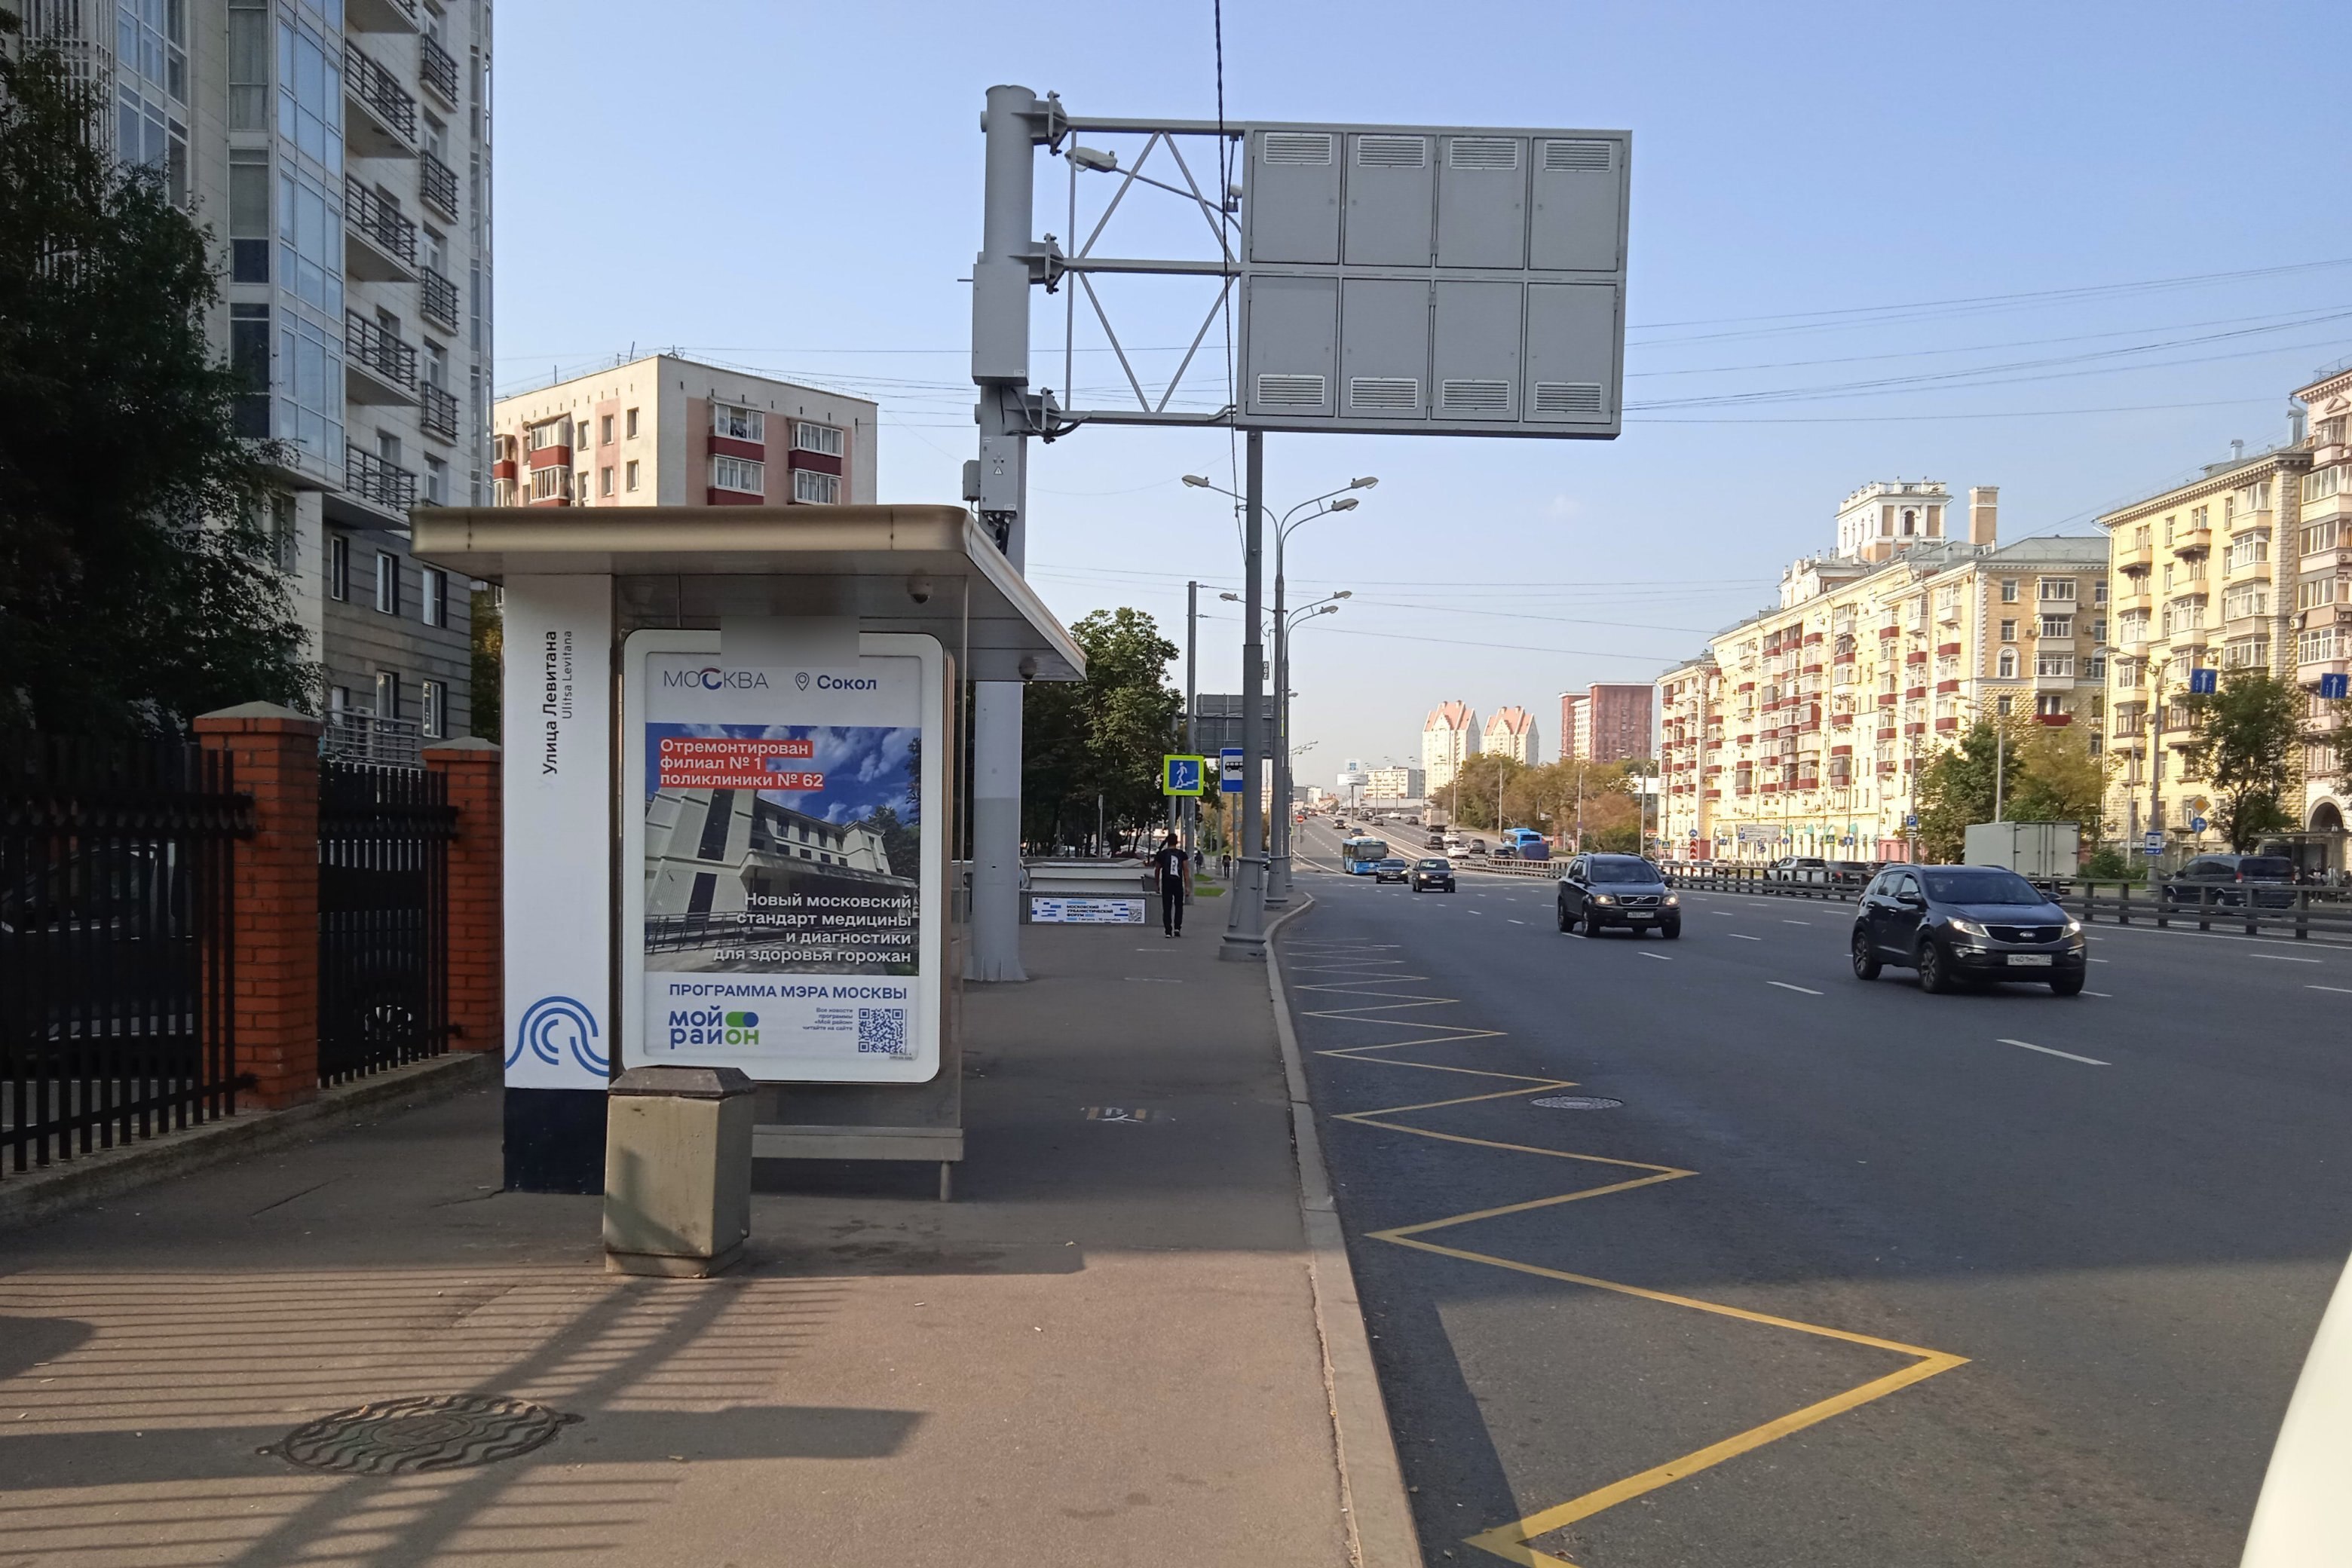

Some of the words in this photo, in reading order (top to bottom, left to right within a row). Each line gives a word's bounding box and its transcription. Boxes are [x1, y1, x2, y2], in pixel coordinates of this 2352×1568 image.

[562, 631, 572, 681] Levitana
[543, 631, 557, 716] Левитана
[663, 667, 769, 690] МОСКВА
[817, 675, 877, 690] Сокол
[562, 684, 572, 719] Ulitsa
[543, 721, 559, 774] Улица
[660, 739, 808, 756] Отремонтирован
[660, 755, 724, 770] филиал
[730, 757, 750, 770] №
[754, 757, 761, 770] 1
[660, 774, 773, 786] поликлиники
[777, 773, 798, 786] №
[802, 773, 824, 787] 62
[745, 893, 802, 906] Новый
[807, 895, 911, 908] московский
[737, 913, 817, 927] стандарт
[822, 914, 911, 927] медицины
[786, 933, 795, 942] и
[800, 933, 911, 945] диагностики
[714, 951, 745, 961] для
[750, 951, 832, 963] здоровья
[838, 951, 911, 965] горожан
[669, 984, 776, 997] ПРОГРАММА
[781, 985, 828, 999] МЭРА
[833, 987, 907, 1000] МОСКВЫ
